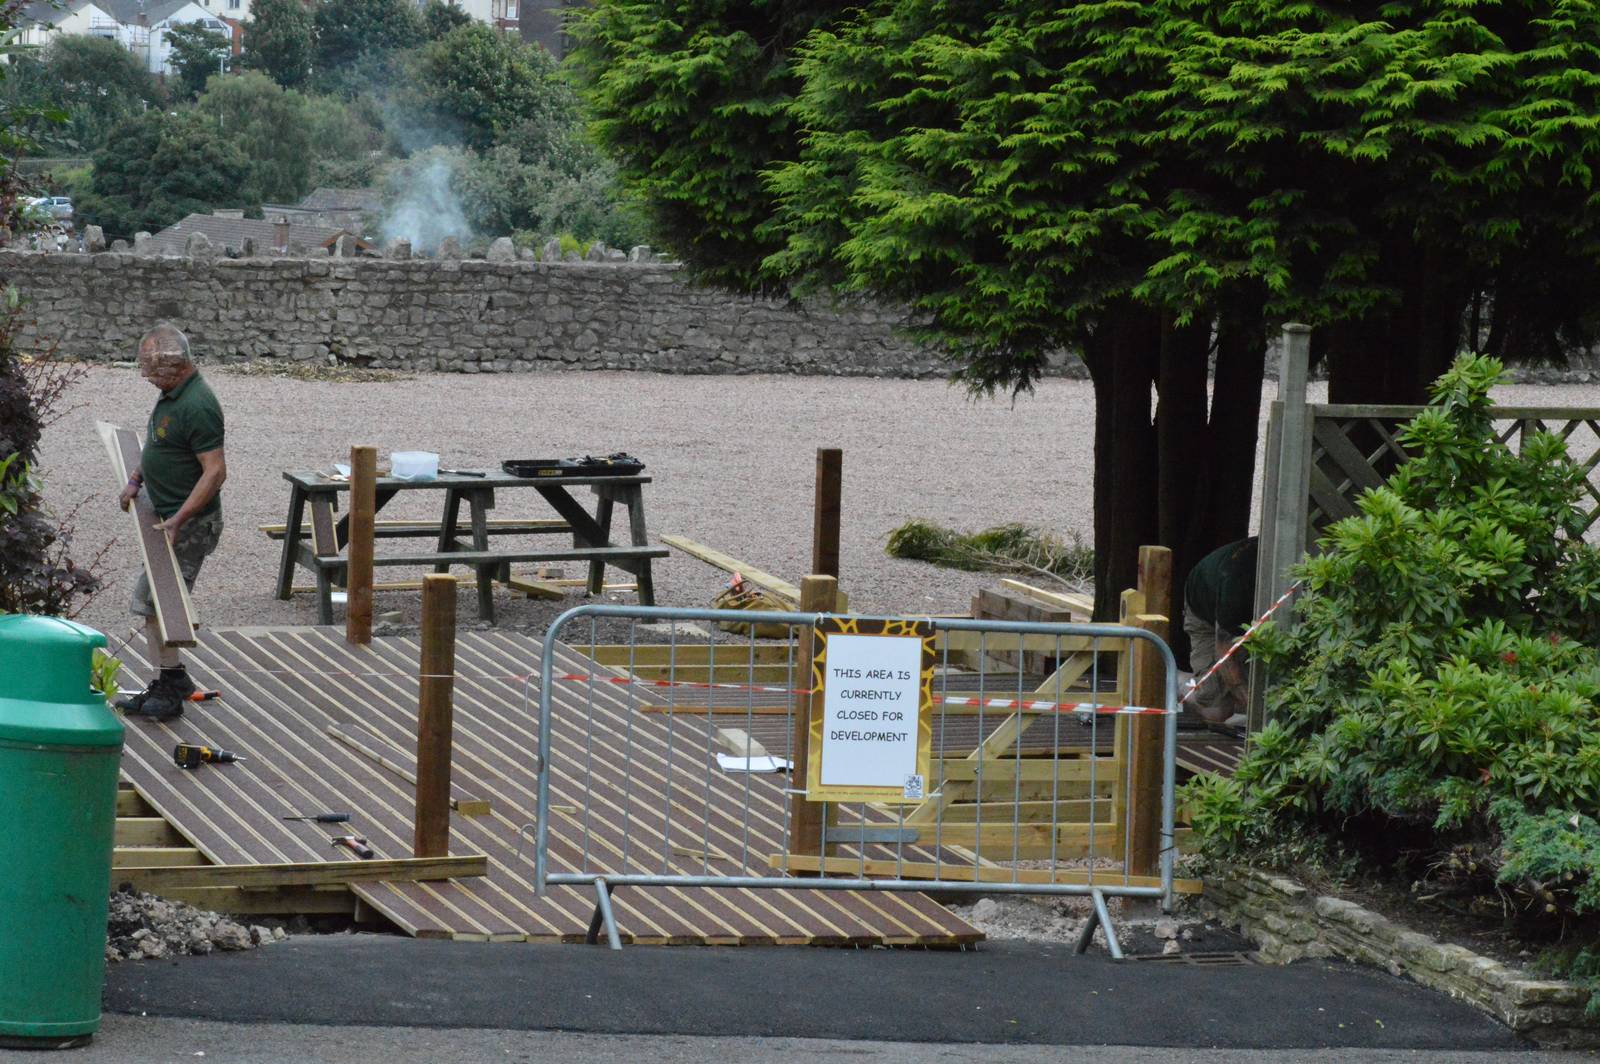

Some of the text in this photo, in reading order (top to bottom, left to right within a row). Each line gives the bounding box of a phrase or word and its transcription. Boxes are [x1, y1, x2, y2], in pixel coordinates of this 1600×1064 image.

[833, 668, 911, 681] THIS AREA IS
[840, 689, 902, 701] CURRENTLY
[837, 710, 904, 721] CLOSED FOR
[830, 730, 908, 742] DEVELOPMENT
